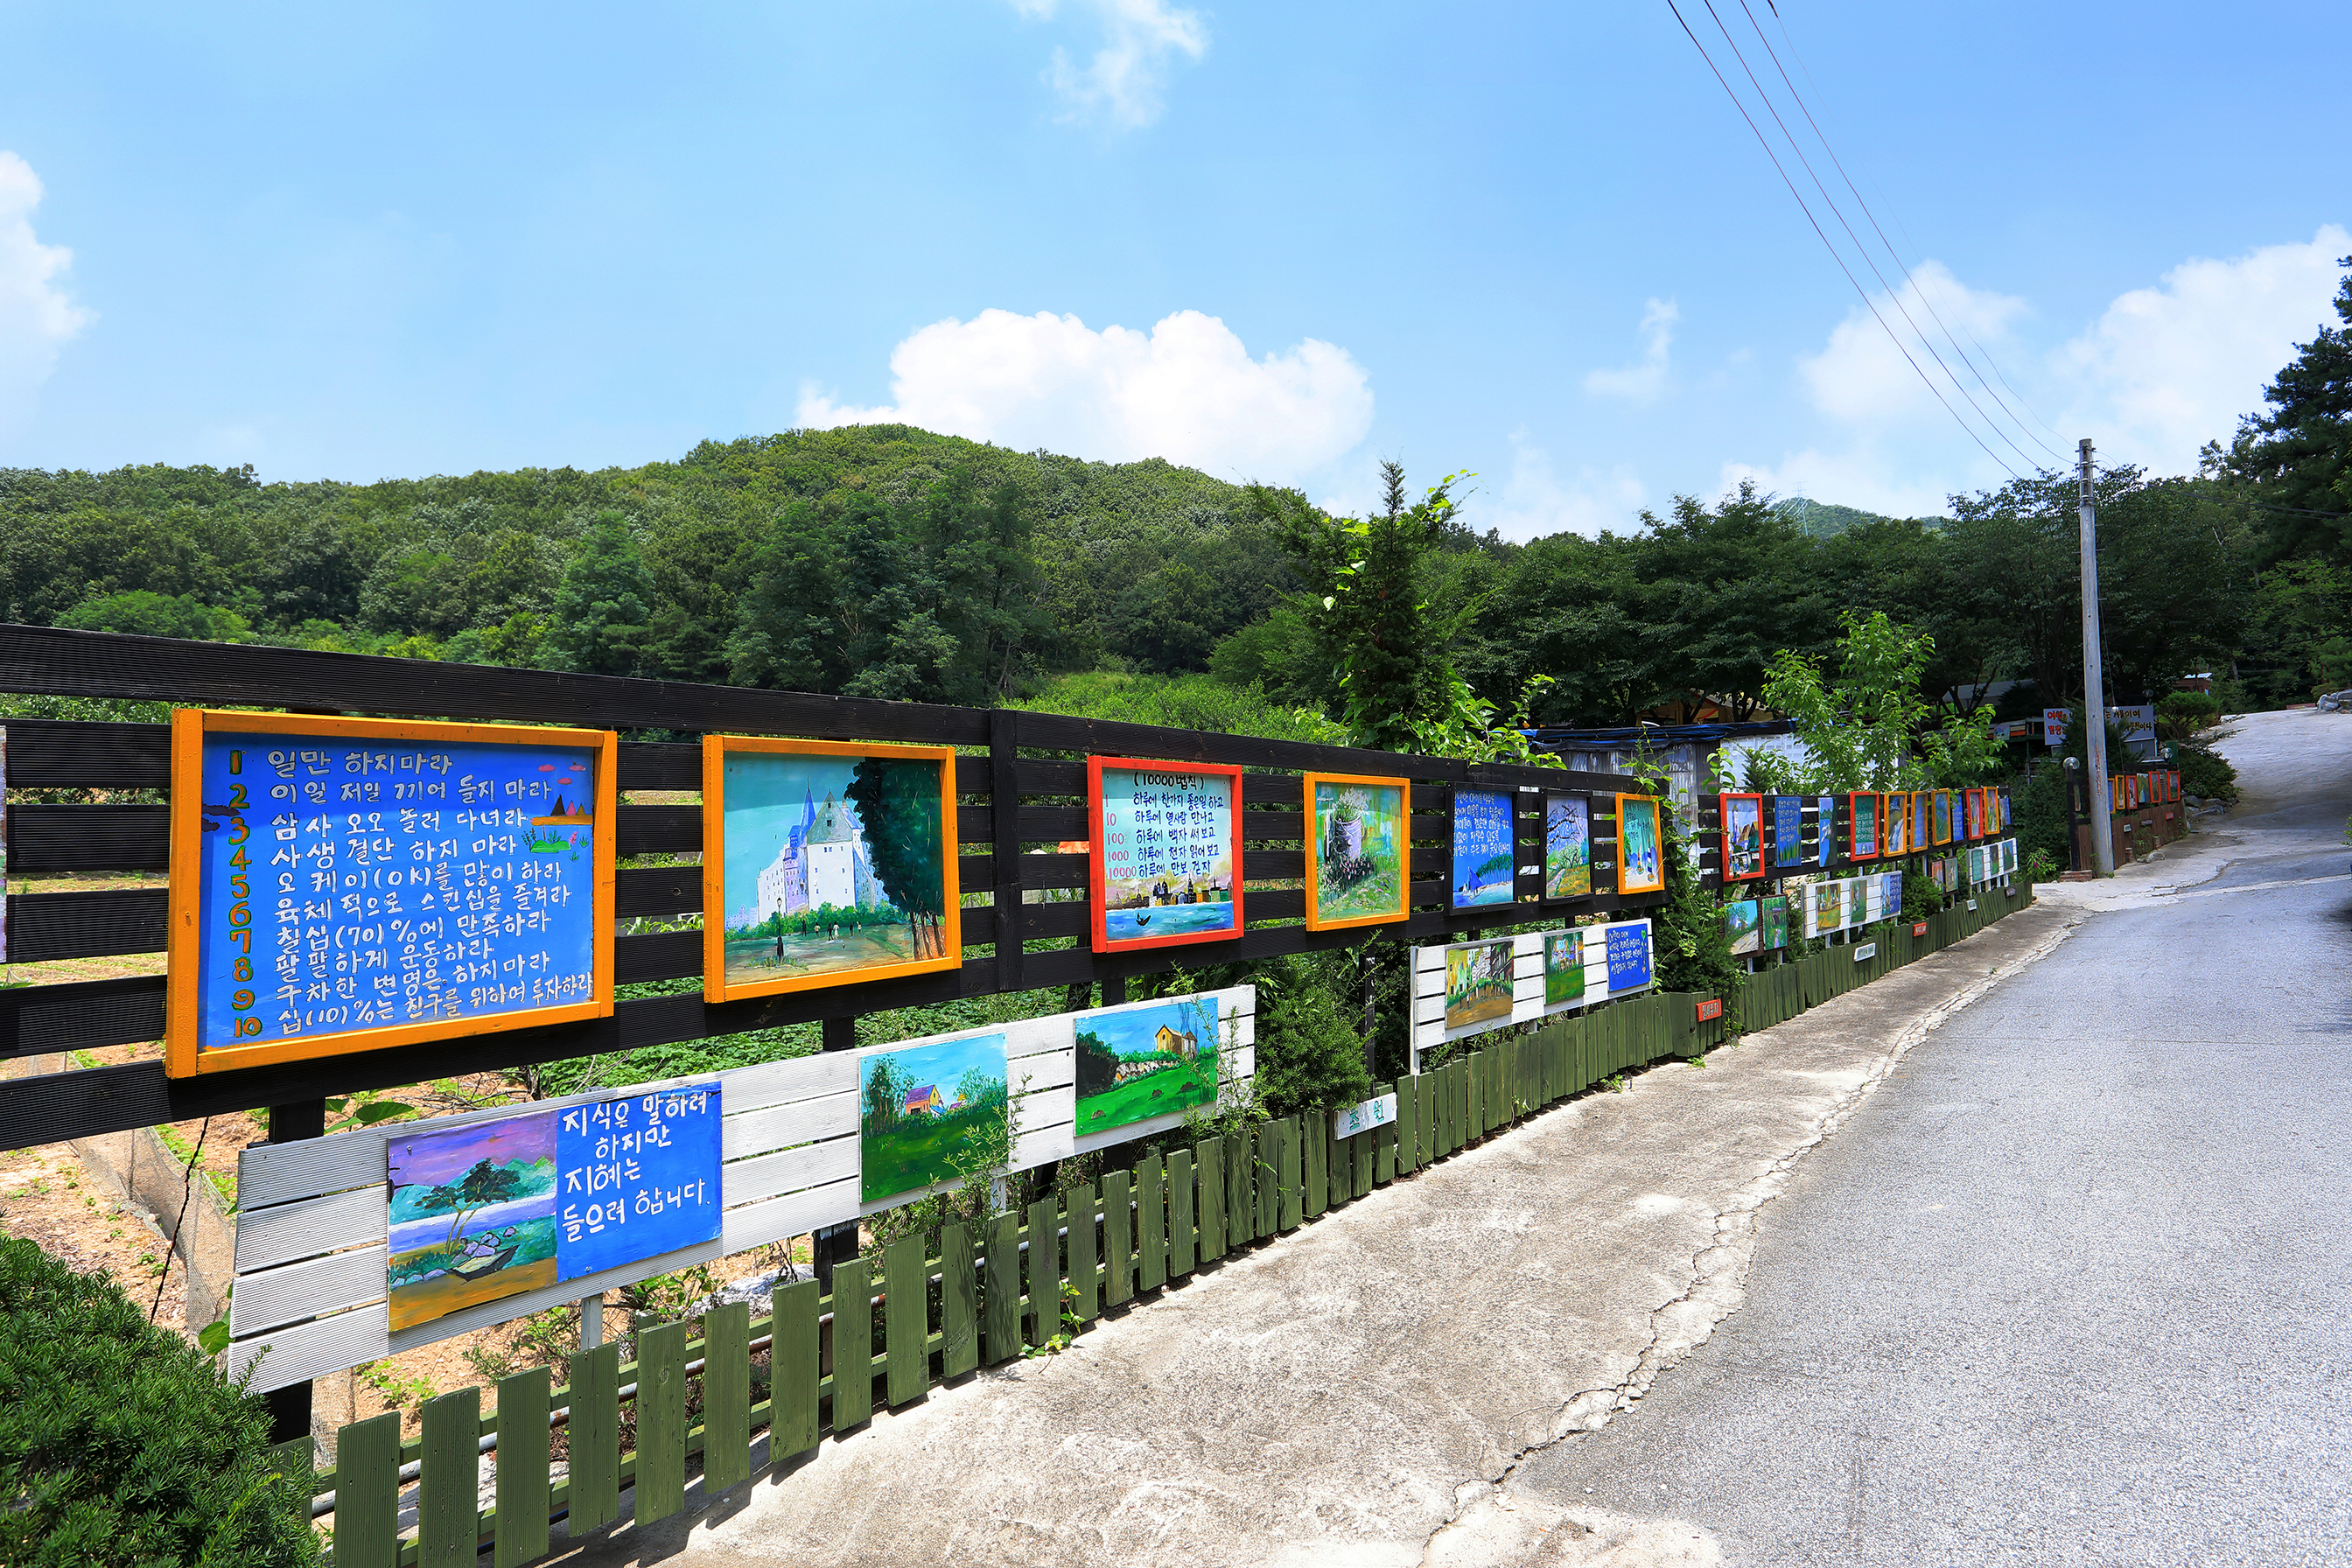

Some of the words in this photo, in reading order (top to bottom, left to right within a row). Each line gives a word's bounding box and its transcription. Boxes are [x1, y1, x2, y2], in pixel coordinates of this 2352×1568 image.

[229, 749, 242, 775] 1
[267, 750, 332, 779] 일만
[229, 783, 250, 809] 2
[458, 774, 495, 804] 들지
[505, 778, 552, 801] 마라
[1133, 791, 1158, 808] 하루에
[1161, 792, 1184, 808] 한가지
[228, 817, 250, 845] 3
[346, 812, 386, 836] 오오
[398, 808, 441, 835] 놀러
[456, 808, 528, 832] 다녀라
[1106, 813, 1117, 827] 10
[1135, 809, 1162, 825] 하루에
[1191, 810, 1214, 824] 만나고
[229, 845, 252, 872] 4
[409, 834, 458, 863] 하지
[472, 834, 518, 857] 마라
[1107, 832, 1124, 846] 100
[1137, 829, 1163, 844] 하루에
[1108, 850, 1130, 863] 1000
[1138, 846, 1165, 862] 하루에
[230, 873, 250, 899] 5
[463, 859, 514, 887] 많이
[521, 859, 564, 884] 하라
[1109, 865, 1138, 879] 10000
[1138, 862, 1166, 878] 하루에
[228, 900, 252, 928] 6
[512, 882, 572, 911] 즐겨라
[229, 928, 252, 955] 7
[457, 908, 552, 939] 만족하라
[232, 956, 254, 983] 8
[399, 937, 495, 970] 운동하라
[231, 988, 256, 1012] 9
[276, 975, 358, 1008] 구차한
[374, 968, 442, 998] 변명은
[234, 1016, 263, 1039] 10
[404, 987, 463, 1019] 친구를
[470, 980, 526, 1008] 위하여
[562, 1101, 630, 1138] 지식은
[641, 1091, 708, 1126] 말하려
[595, 1124, 672, 1161] 하지만
[564, 1158, 641, 1197] 지혜는
[562, 1198, 626, 1243] 들으려
